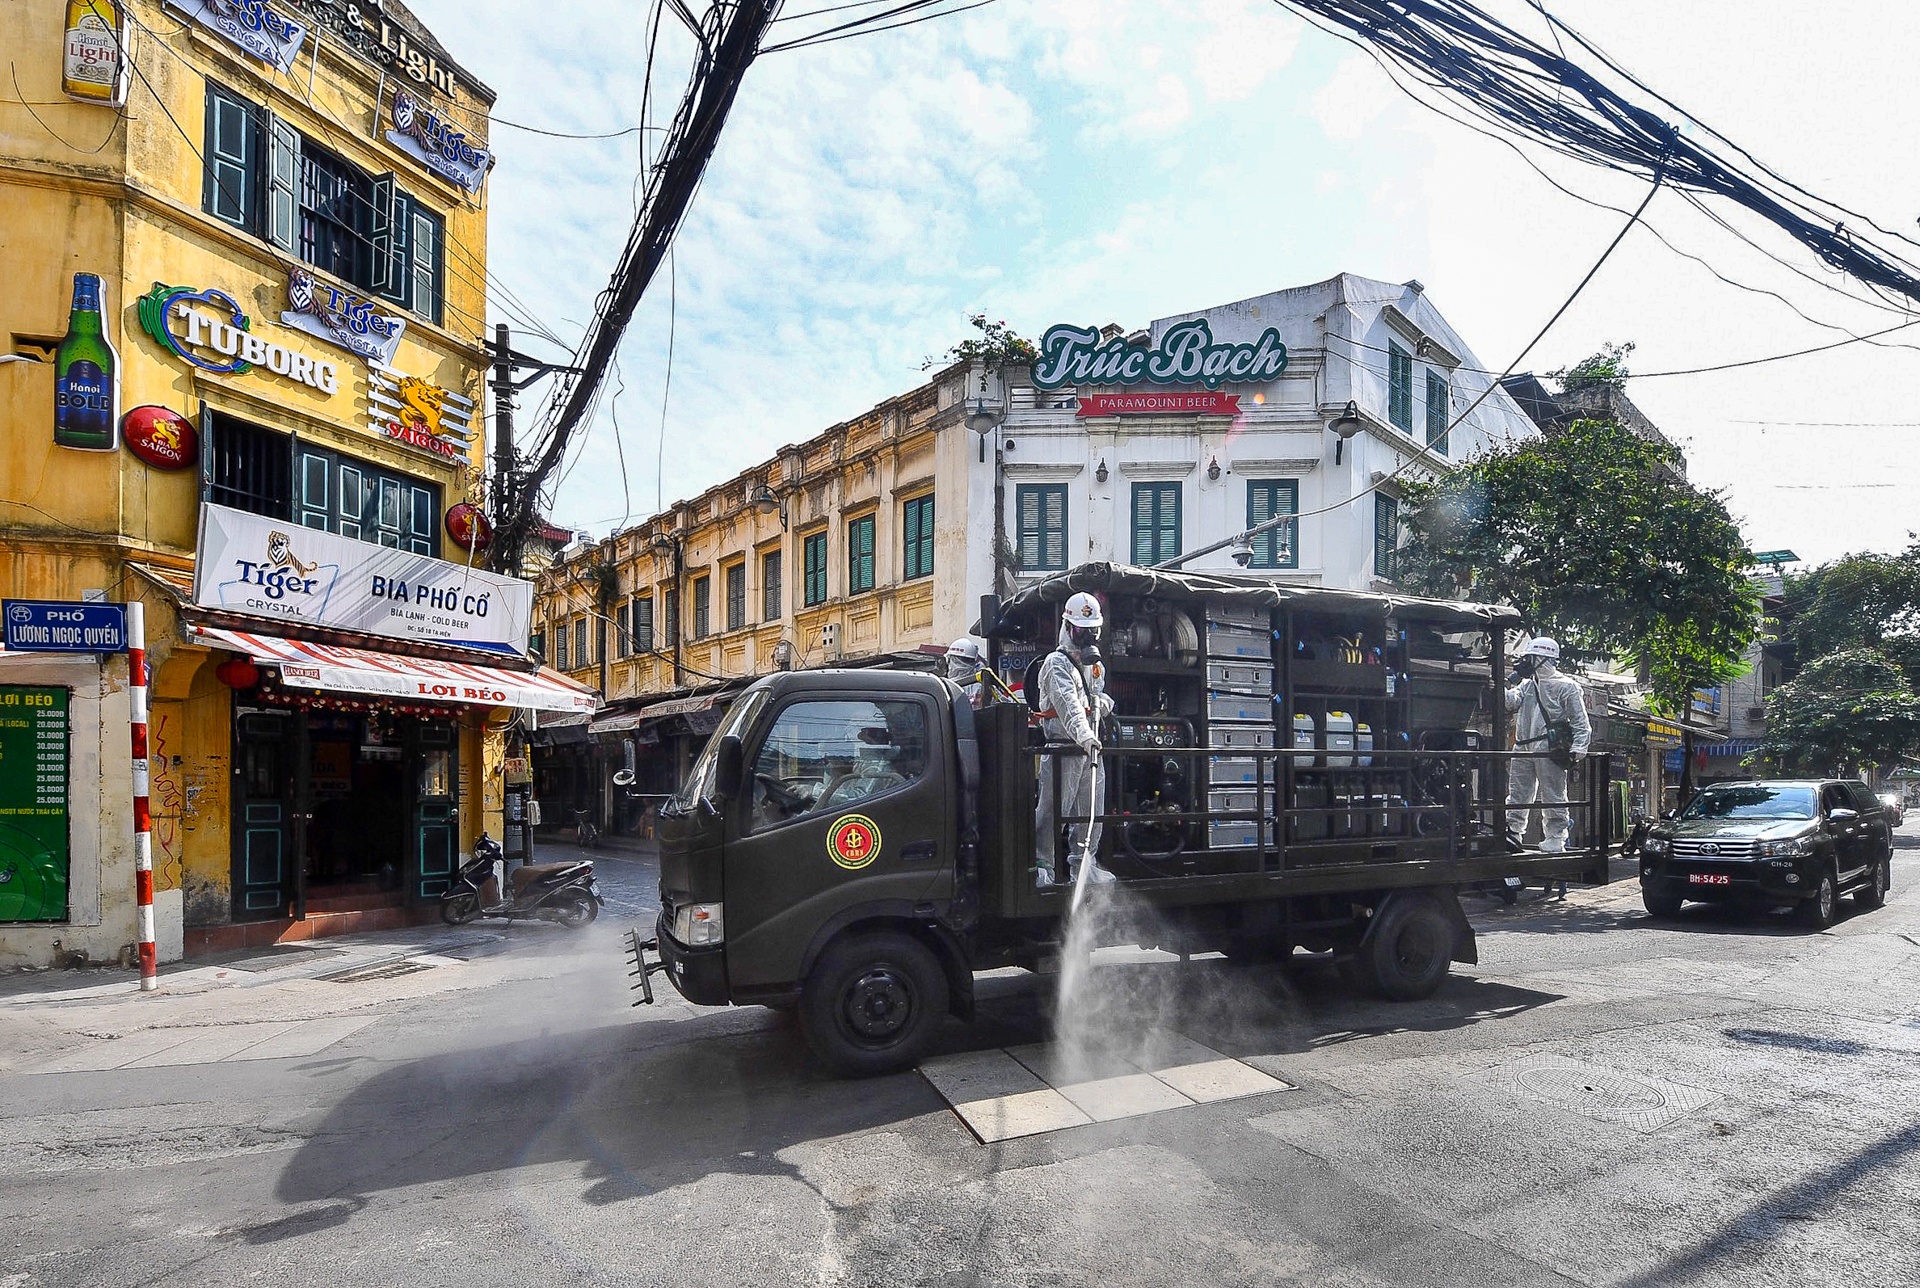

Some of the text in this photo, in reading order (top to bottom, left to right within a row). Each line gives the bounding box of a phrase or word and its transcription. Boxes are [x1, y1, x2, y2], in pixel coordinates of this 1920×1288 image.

[231, 0, 300, 43] ger
[216, 16, 282, 61] CRYSTAL
[347, 4, 365, 31] &
[380, 20, 457, 98] Light
[70, 43, 116, 64] Light
[423, 111, 485, 169] Tiger
[426, 151, 471, 185] CRYSTAL
[325, 285, 400, 338] Tiger
[178, 304, 339, 395] TUBORG
[330, 328, 387, 357] CRYSTAL
[1036, 322, 1284, 385] Trúc Bạch
[70, 382, 100, 394] Hanoi
[58, 393, 111, 412] BOLD
[1099, 396, 1217, 408] PARAMOUNT BEER
[140, 438, 182, 461] SAIGON
[386, 421, 455, 457] SAIGON
[236, 559, 318, 599] Tiger
[246, 598, 302, 616] CRYSTAL
[371, 575, 491, 618] BIA PHỐ CỔ
[46, 608, 84, 621] PHỐ
[390, 608, 403, 618] BIA
[406, 610, 426, 622] LẠNH
[432, 616, 450, 626] COLD
[452, 618, 470, 630] BEER
[13, 623, 118, 647] LƯƠNG NGỌC QUYẾN
[26, 693, 53, 706] BÉO
[418, 683, 506, 702] LỢI BÉO
[1689, 874, 1728, 884] BH-54-25
